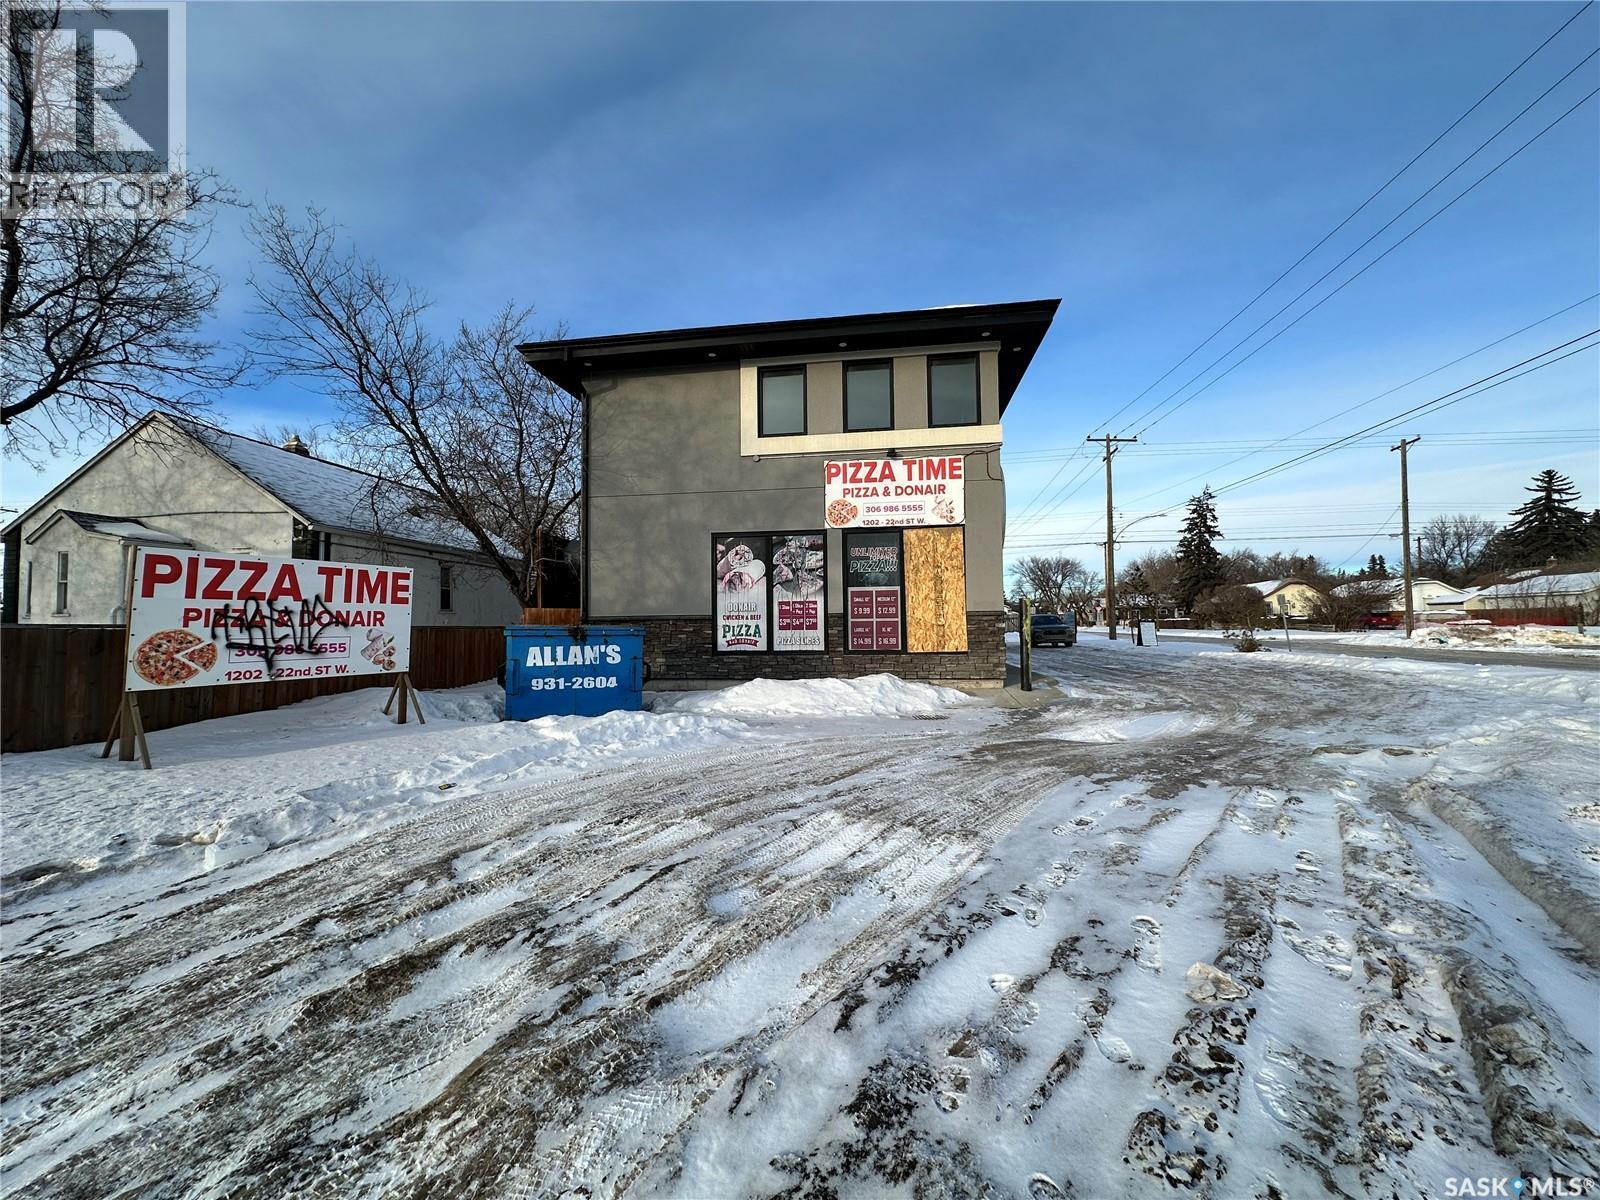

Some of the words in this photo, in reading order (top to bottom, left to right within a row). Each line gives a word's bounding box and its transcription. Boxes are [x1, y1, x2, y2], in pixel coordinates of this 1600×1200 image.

[826, 461, 896, 484] PIZZA
[902, 457, 962, 481] TIME
[842, 486, 879, 498] PIZZA
[882, 486, 891, 497] &
[894, 484, 946, 496] DONAIR
[901, 504, 924, 512] 5555
[886, 517, 904, 526] 22nd
[850, 560, 898, 572] PIZZA!!!
[141, 553, 303, 602] PIZZA
[317, 566, 411, 605] TIME
[727, 602, 757, 612] DONAIR
[182, 607, 267, 628] PIZZA
[299, 610, 385, 628] DONAIR
[722, 624, 762, 638] PIZZA
[777, 637, 795, 645] PIZZA
[796, 637, 820, 645] SLICES
[526, 645, 622, 667] ALLAN'S
[225, 670, 262, 681] 1202
[315, 665, 331, 675] ST
[531, 676, 618, 691] 931-2604
